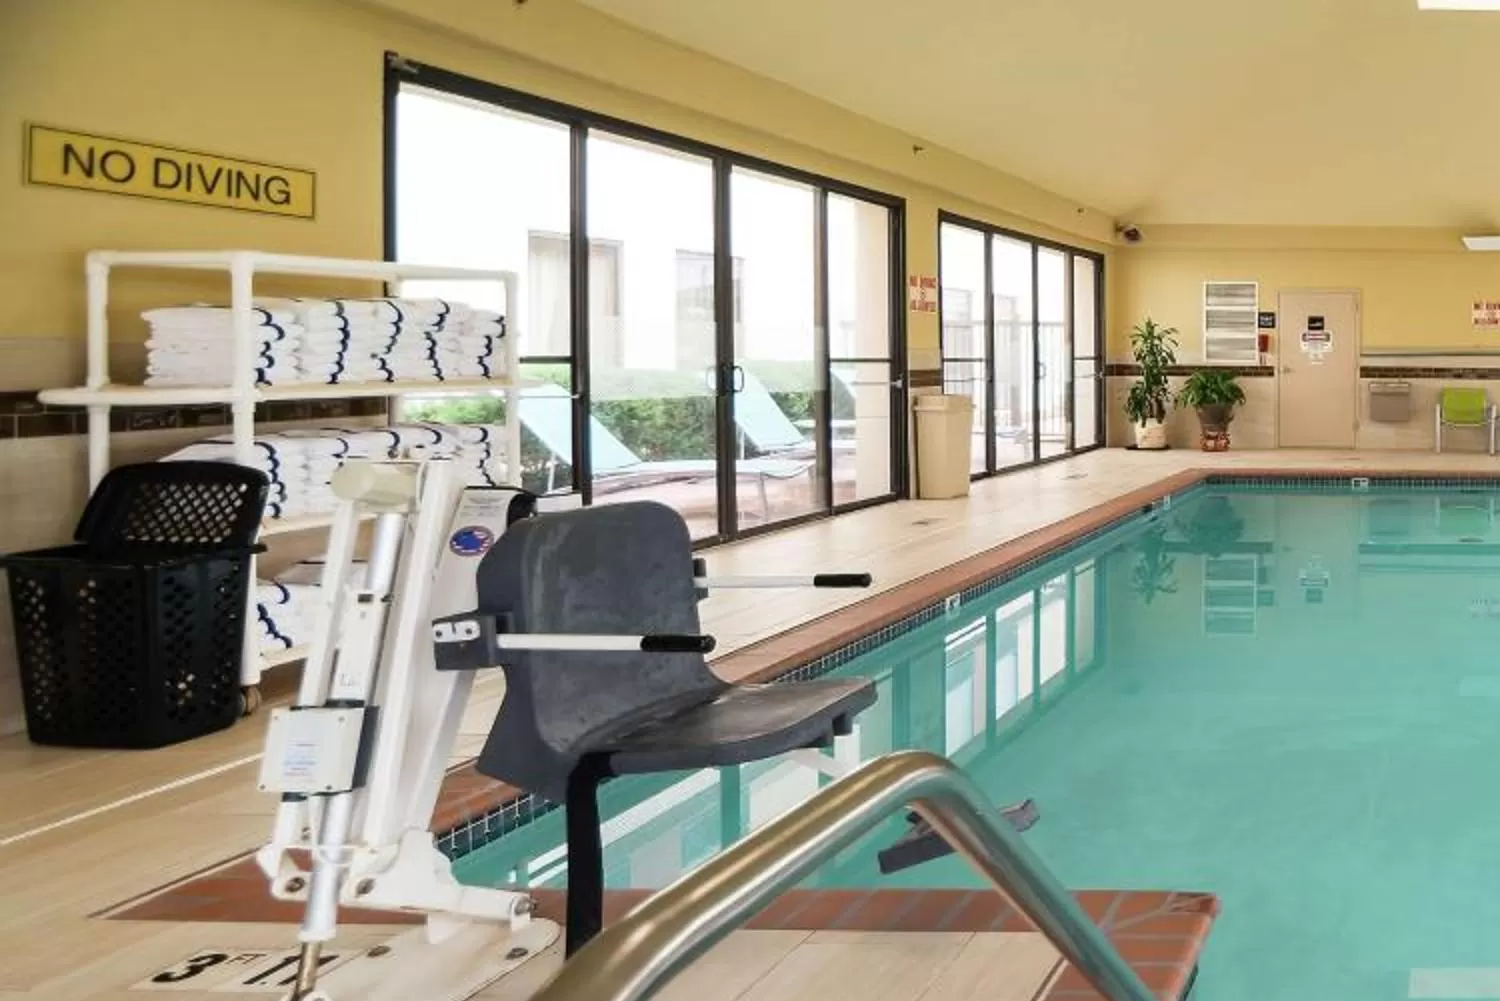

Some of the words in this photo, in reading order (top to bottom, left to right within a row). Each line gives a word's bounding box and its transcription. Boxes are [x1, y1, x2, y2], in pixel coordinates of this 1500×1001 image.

[62, 143, 136, 184] NO
[153, 157, 292, 206] DIVING
[151, 953, 229, 983] 3
